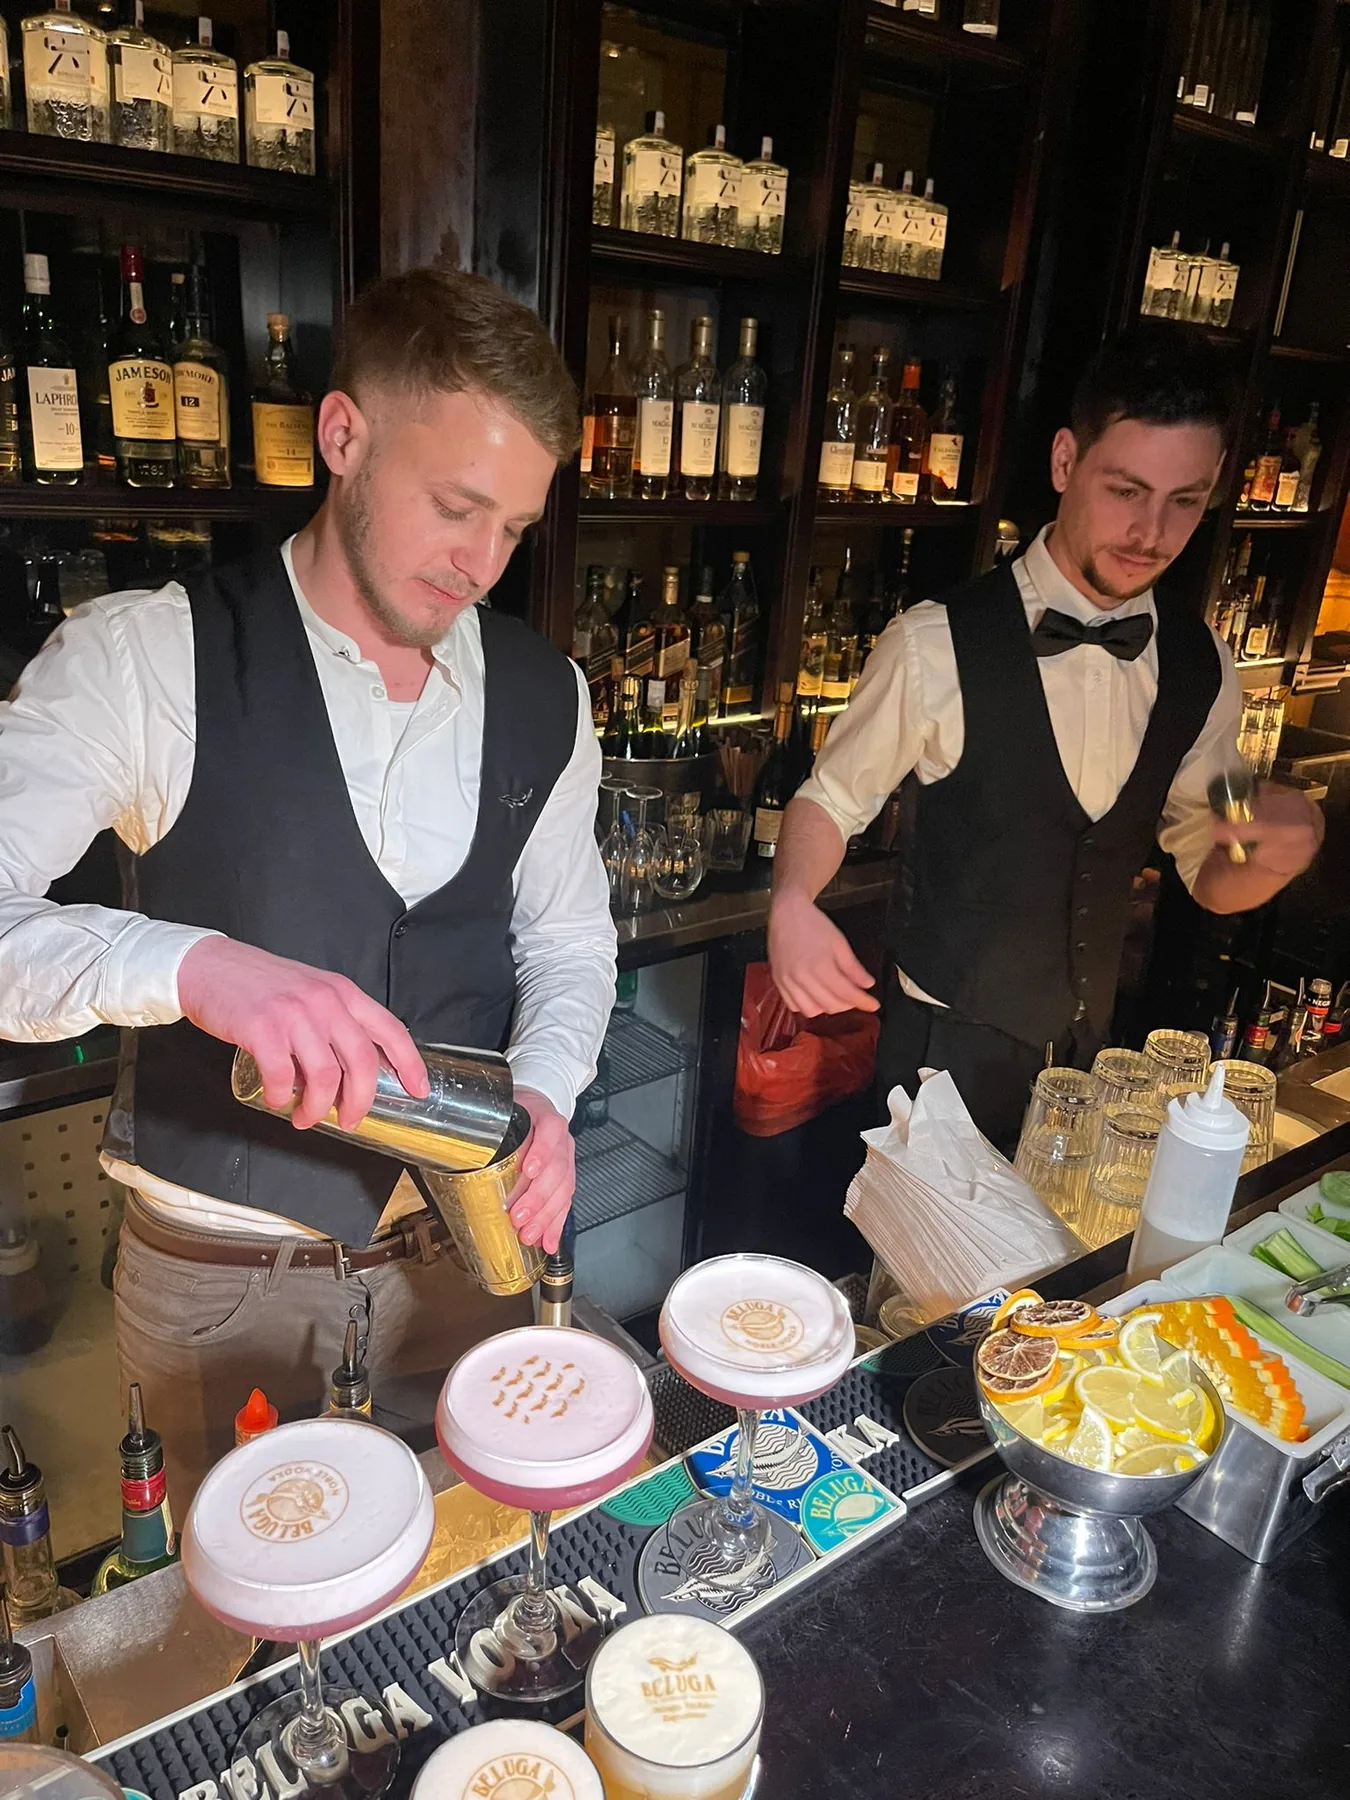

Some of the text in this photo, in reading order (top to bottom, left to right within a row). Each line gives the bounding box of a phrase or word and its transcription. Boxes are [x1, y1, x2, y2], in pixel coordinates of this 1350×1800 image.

[115, 366, 171, 384] JAMESON
[185, 397, 196, 407] 12
[65, 422, 75, 436] 10
[810, 1475, 875, 1520] BELUGA
[247, 1507, 314, 1539] BELUGA
[640, 1673, 717, 1697] BELUGA
[471, 1758, 542, 1798] BELUGA
